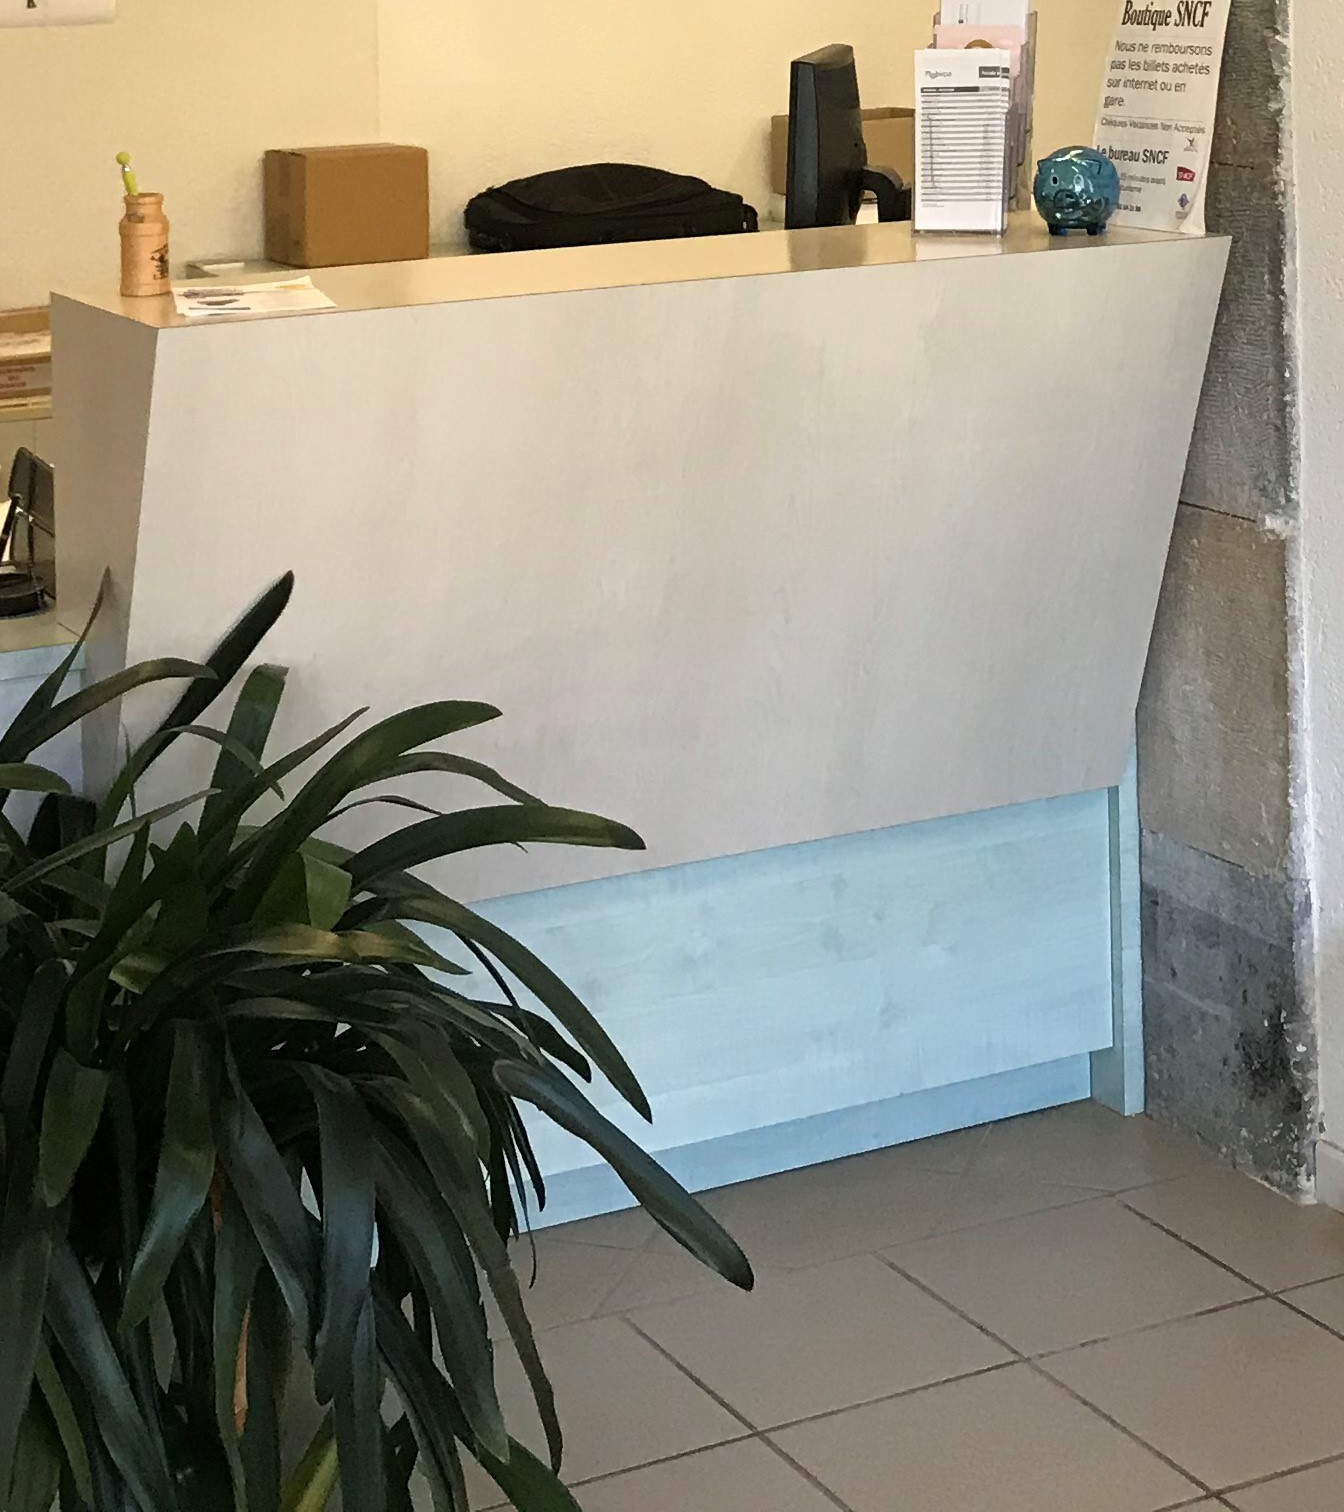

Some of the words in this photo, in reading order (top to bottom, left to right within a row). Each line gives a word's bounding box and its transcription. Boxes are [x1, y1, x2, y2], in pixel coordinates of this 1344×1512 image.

[1121, 0, 1172, 31] Boutique
[1173, 0, 1212, 28] SNCF
[1115, 40, 1136, 52] Nous
[1137, 43, 1149, 53] ne
[1151, 42, 1213, 56] remboursons
[1110, 60, 1126, 72] pas
[1128, 59, 1142, 71] les
[1143, 59, 1170, 73] billets
[1107, 78, 1122, 88] sur
[1122, 76, 1158, 91] internet
[1159, 81, 1173, 92] ou
[1174, 82, 1187, 93] en
[1108, 145, 1140, 163] bureau
[1141, 148, 1170, 165] SNCF
